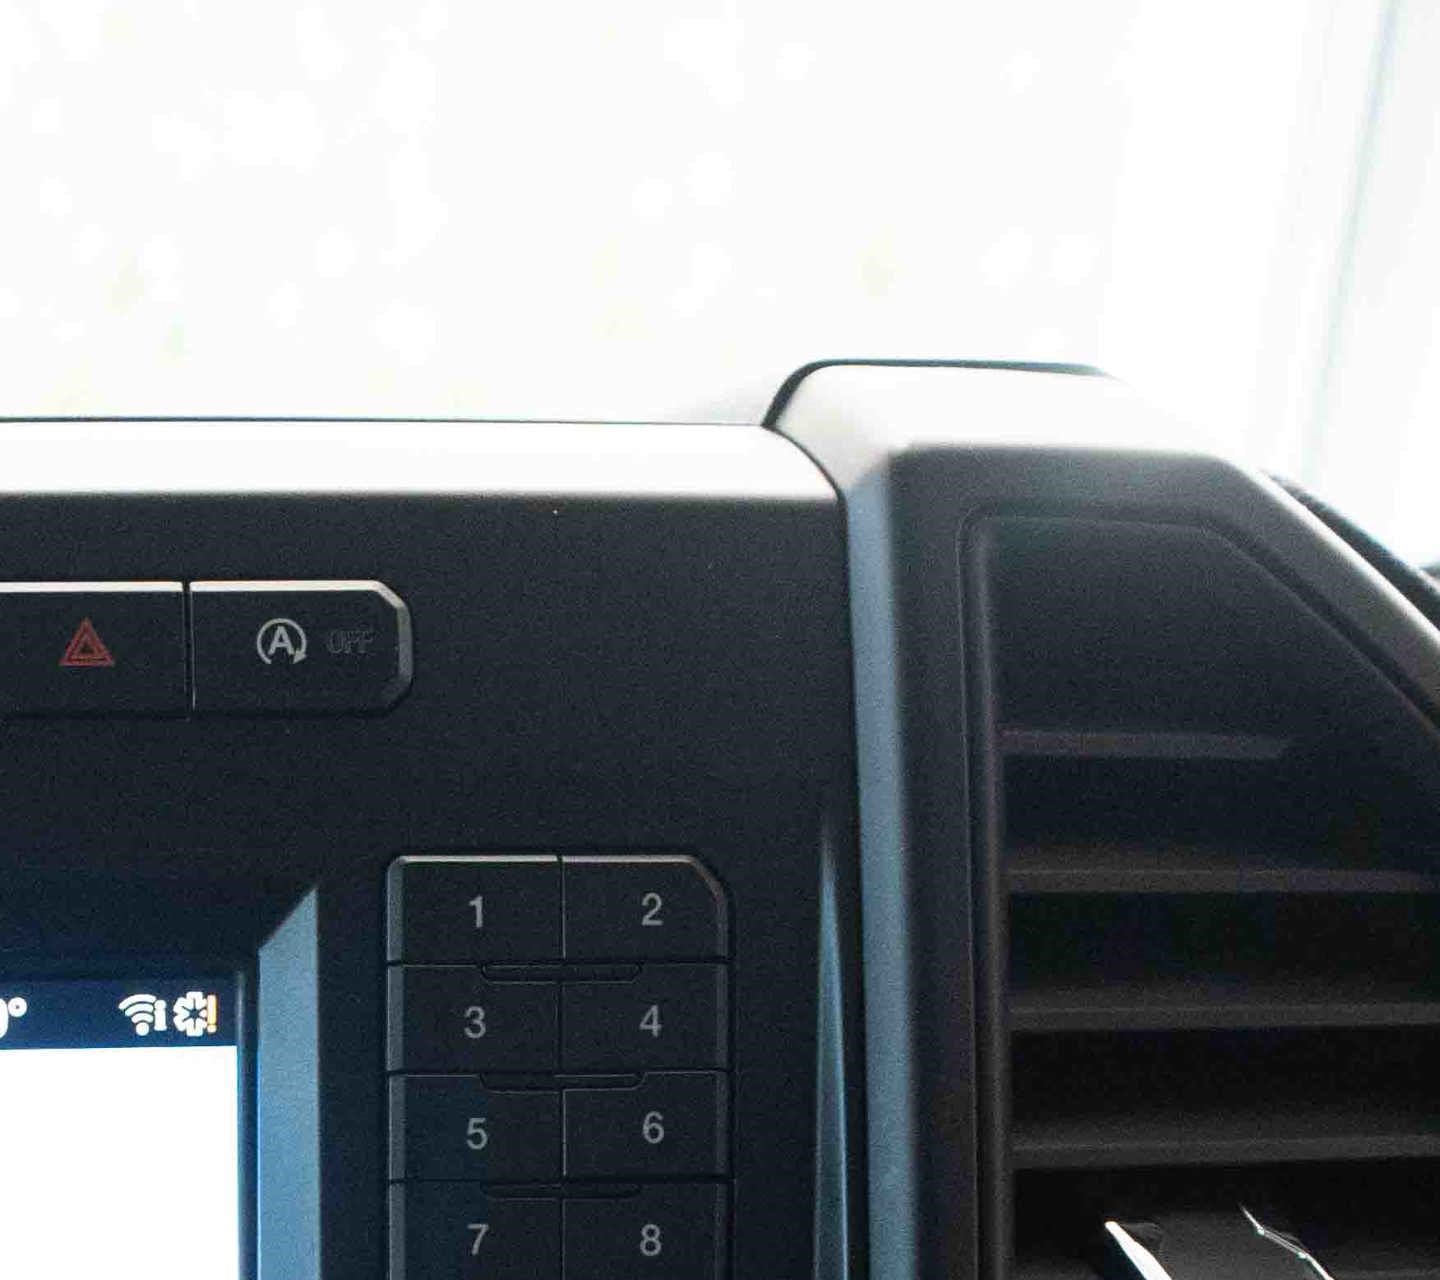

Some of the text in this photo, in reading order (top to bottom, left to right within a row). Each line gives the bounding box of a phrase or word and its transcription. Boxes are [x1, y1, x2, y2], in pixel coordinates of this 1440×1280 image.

[469, 895, 483, 929] 1
[641, 893, 663, 926] 2
[464, 1005, 487, 1039] 3
[639, 1004, 662, 1037] 4
[466, 1117, 488, 1150] 5
[642, 1111, 665, 1144] 6
[467, 1223, 489, 1256] 7
[639, 1223, 662, 1257] 8
